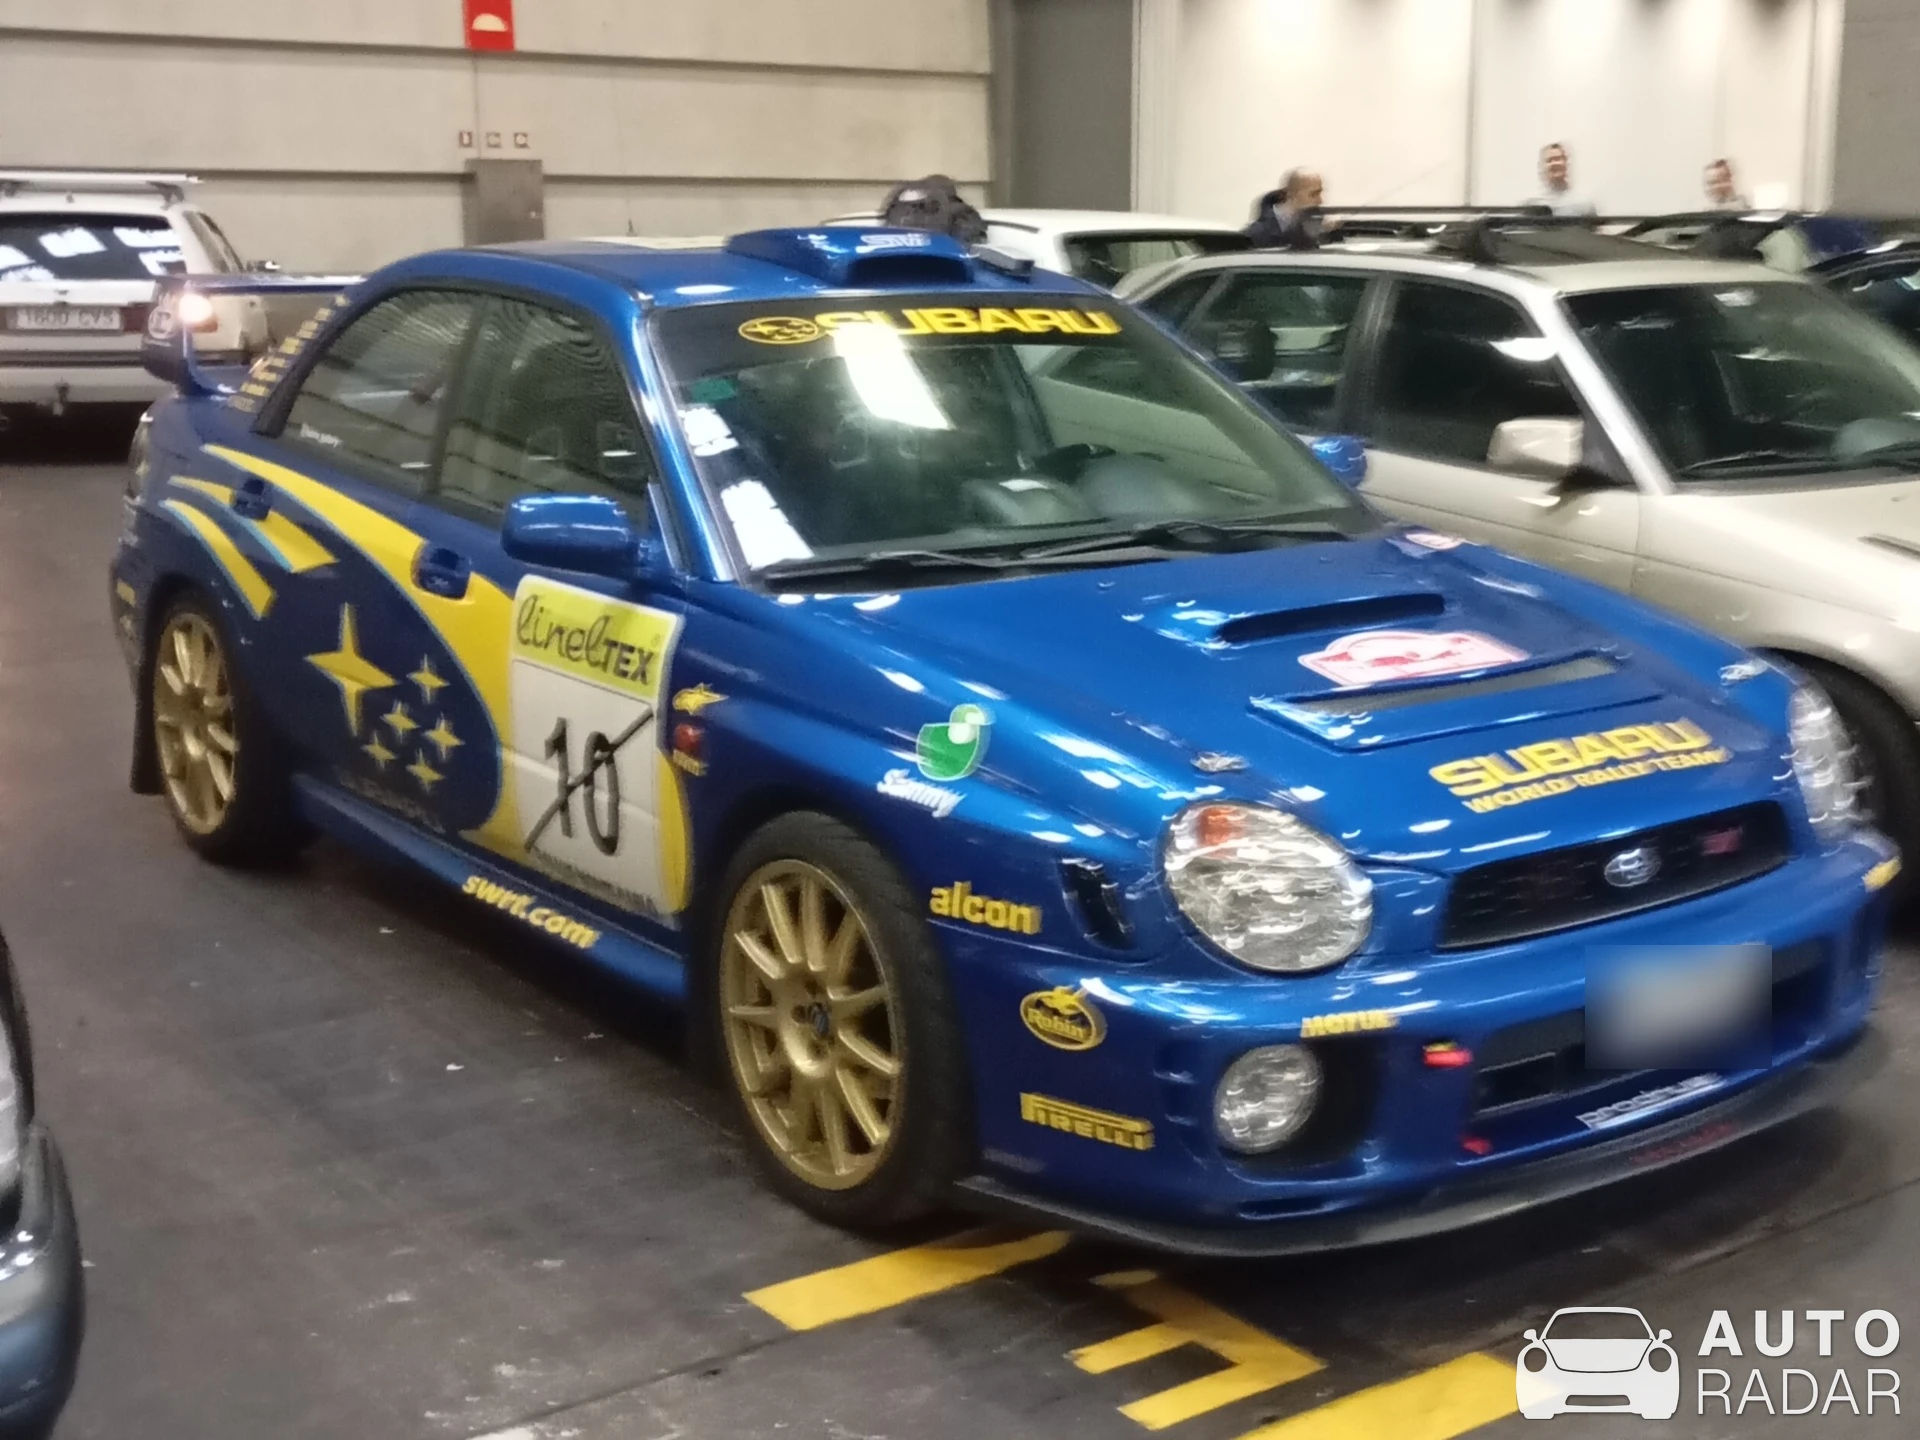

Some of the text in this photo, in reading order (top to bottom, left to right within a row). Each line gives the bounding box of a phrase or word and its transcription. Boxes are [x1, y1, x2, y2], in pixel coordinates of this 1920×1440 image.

[815, 308, 1122, 335] SUBARU
[545, 716, 620, 856] 10
[1429, 718, 1712, 796] SUBARU
[1461, 775, 1577, 814] WORLD
[1572, 757, 1656, 788] RALLY
[462, 875, 600, 948] swrt.com
[930, 880, 1042, 935] alcon
[1020, 1091, 1155, 1150] PIRELLI
